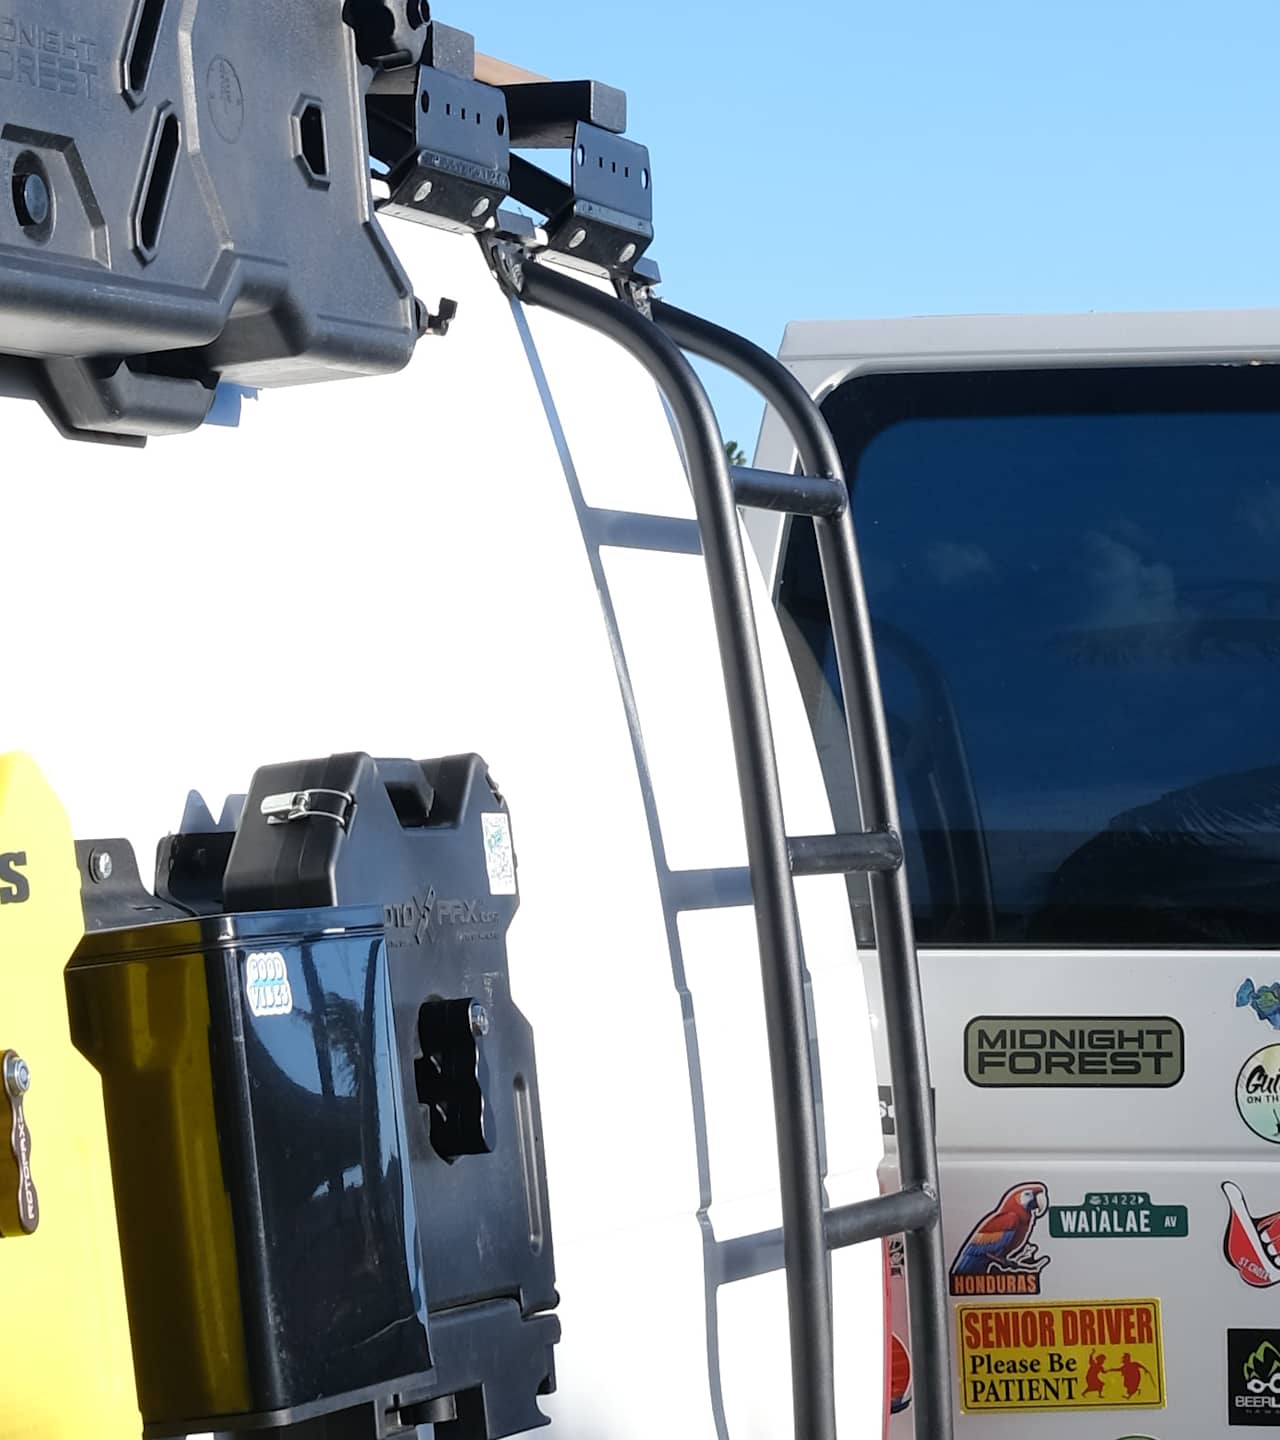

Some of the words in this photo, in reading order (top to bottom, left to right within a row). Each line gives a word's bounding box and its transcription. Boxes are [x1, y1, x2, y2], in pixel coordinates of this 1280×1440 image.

[249, 956, 285, 982] GOOD
[977, 1029, 1173, 1050] MIDNIGHT
[977, 1051, 1174, 1075] FOREST
[1246, 1095, 1262, 1104] ON
[1102, 1194, 1136, 1205] 3422
[1164, 1216, 1177, 1228] AV
[954, 1274, 1037, 1294] HONDURAS
[965, 1310, 1056, 1350] SENIOR
[1061, 1307, 1154, 1347] DRIVER
[970, 1353, 1041, 1375] Please
[1048, 1352, 1078, 1373] Be
[971, 1376, 1079, 1403] PATIENT
